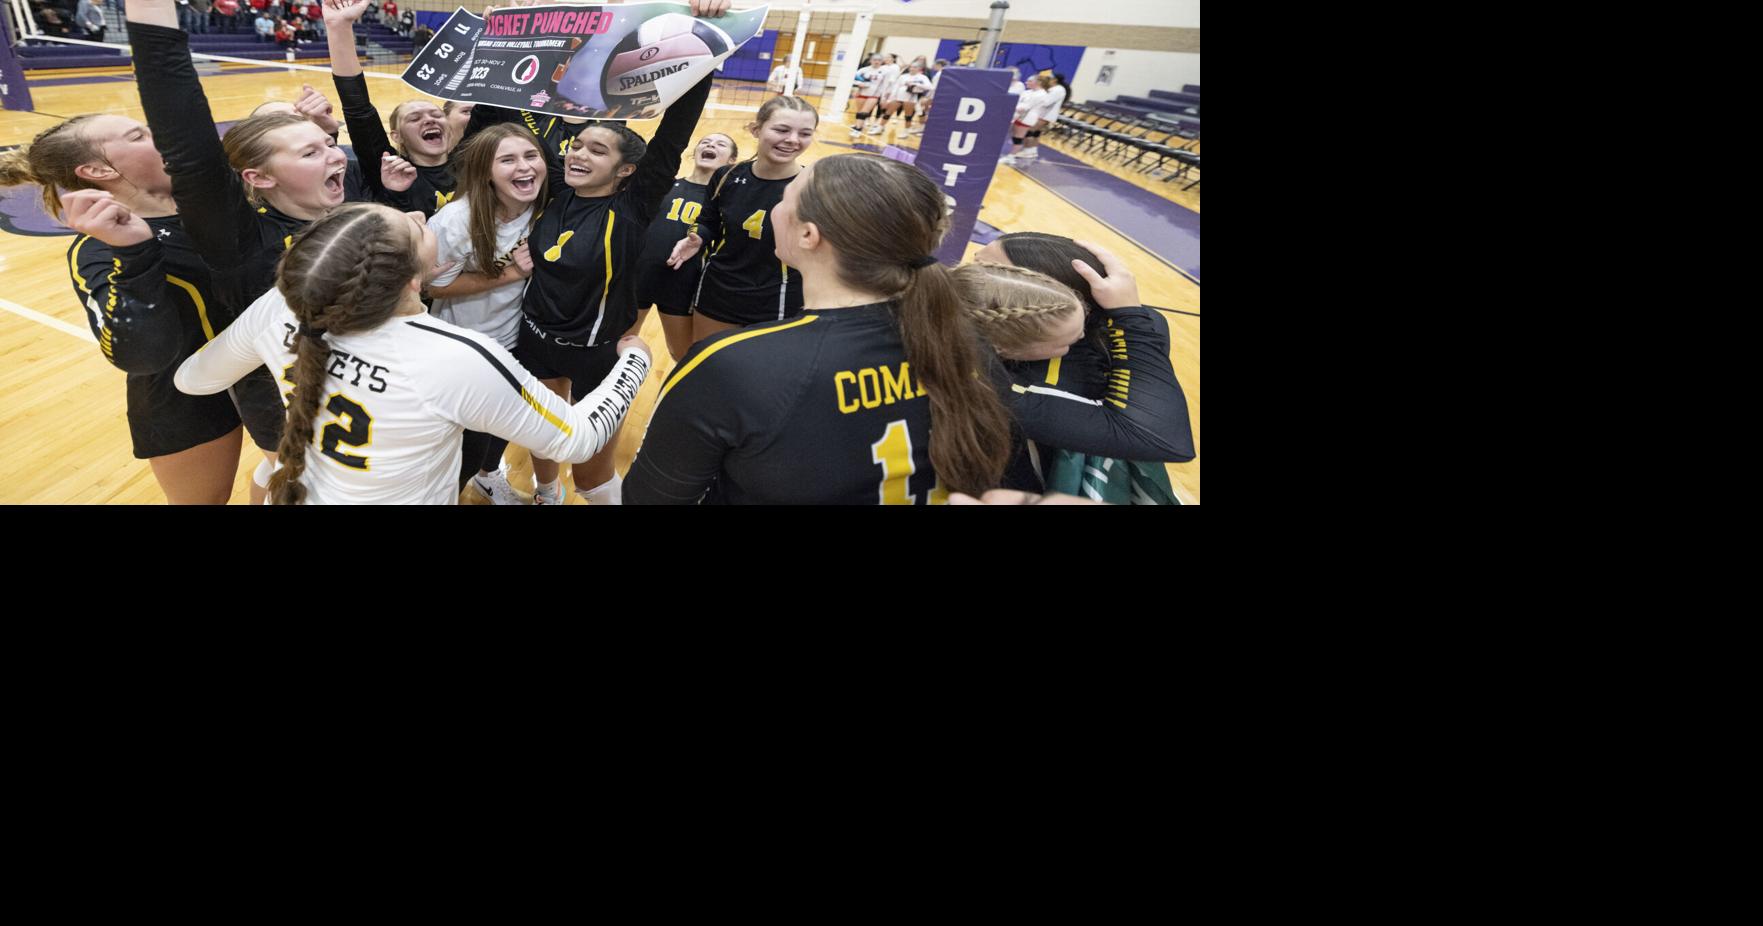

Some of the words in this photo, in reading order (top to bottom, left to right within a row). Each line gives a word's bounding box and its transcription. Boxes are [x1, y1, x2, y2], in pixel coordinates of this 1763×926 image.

[530, 11, 613, 35] PUNCHED
[434, 43, 454, 59] 02
[533, 39, 566, 48] TOURNAMENT
[416, 63, 436, 81] 23
[619, 61, 689, 91] SPALDING
[666, 197, 702, 225] 10
[742, 208, 767, 240] 4
[834, 361, 929, 414] COM
